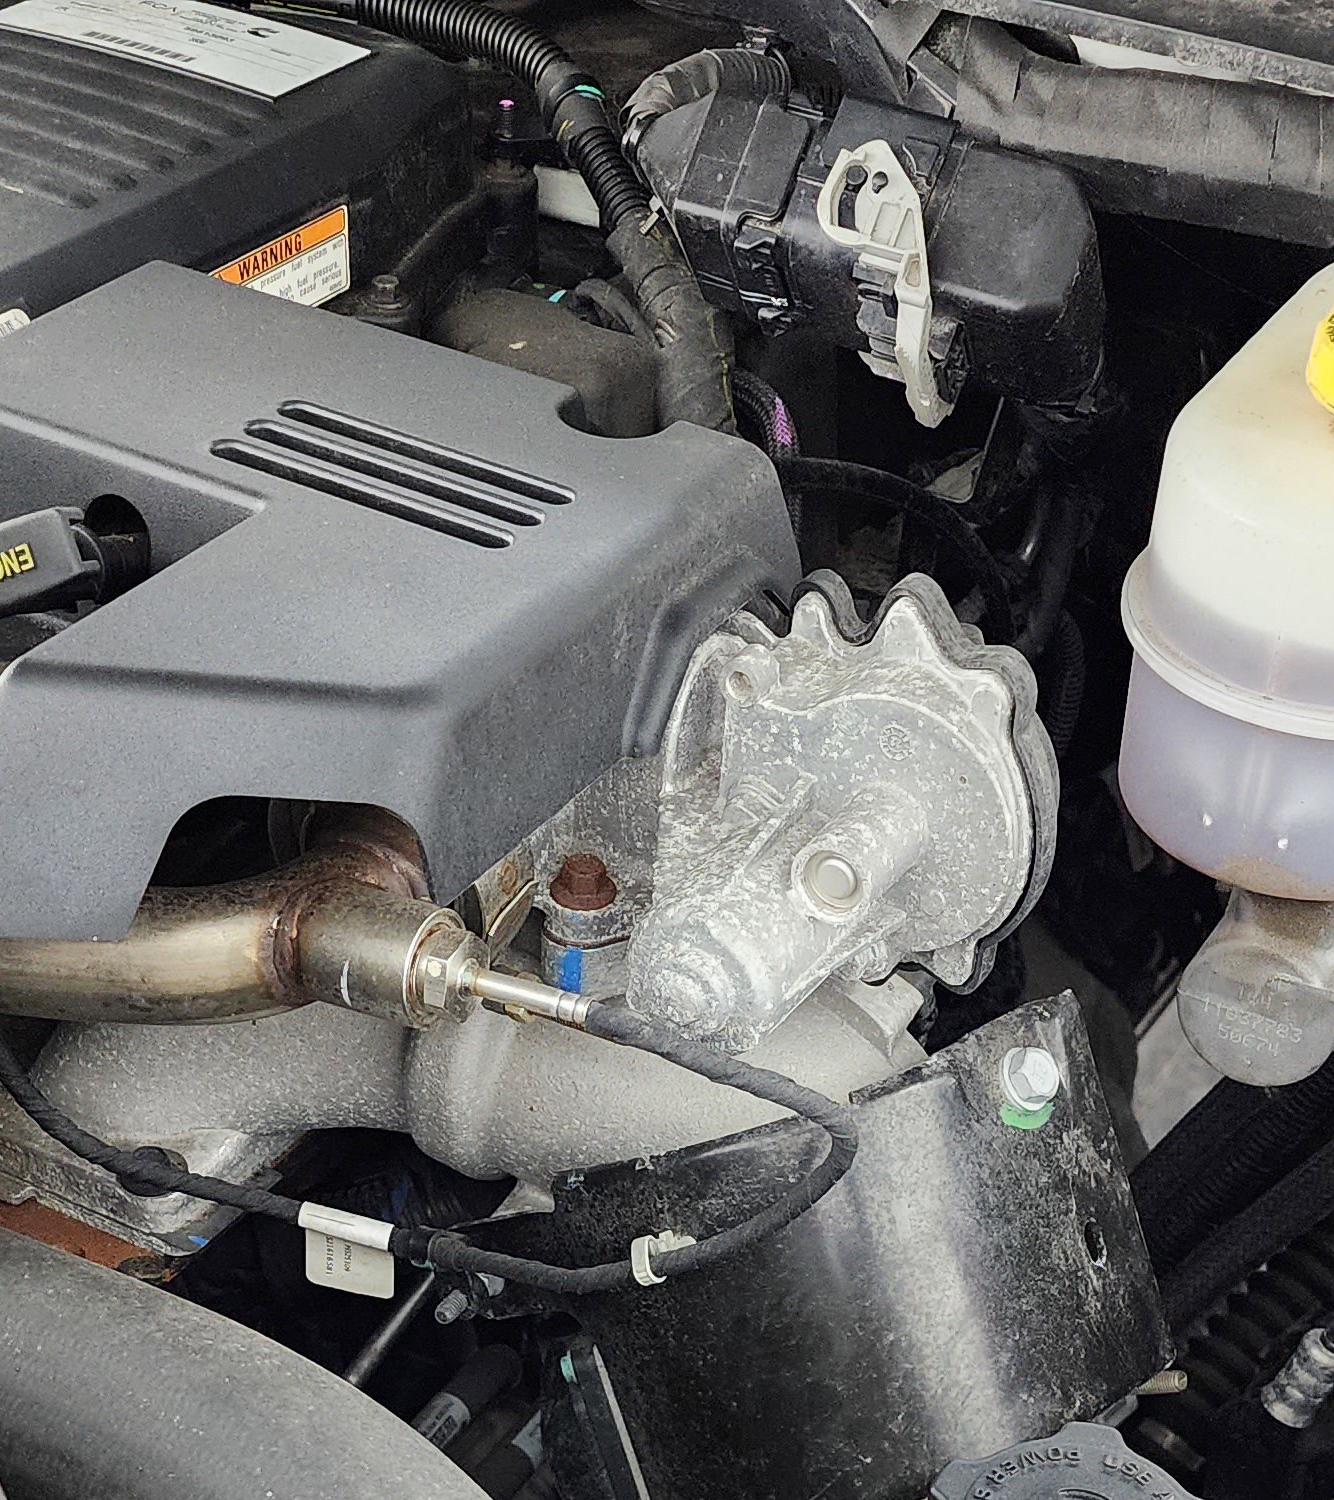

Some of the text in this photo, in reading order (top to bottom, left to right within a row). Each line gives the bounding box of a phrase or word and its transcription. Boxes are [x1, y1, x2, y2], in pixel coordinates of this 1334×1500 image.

[237, 233, 303, 281] WARNING
[260, 268, 286, 291] pressure
[307, 246, 328, 266] system
[985, 1447, 1082, 1486] POWER
[1102, 1454, 1154, 1487] USE
